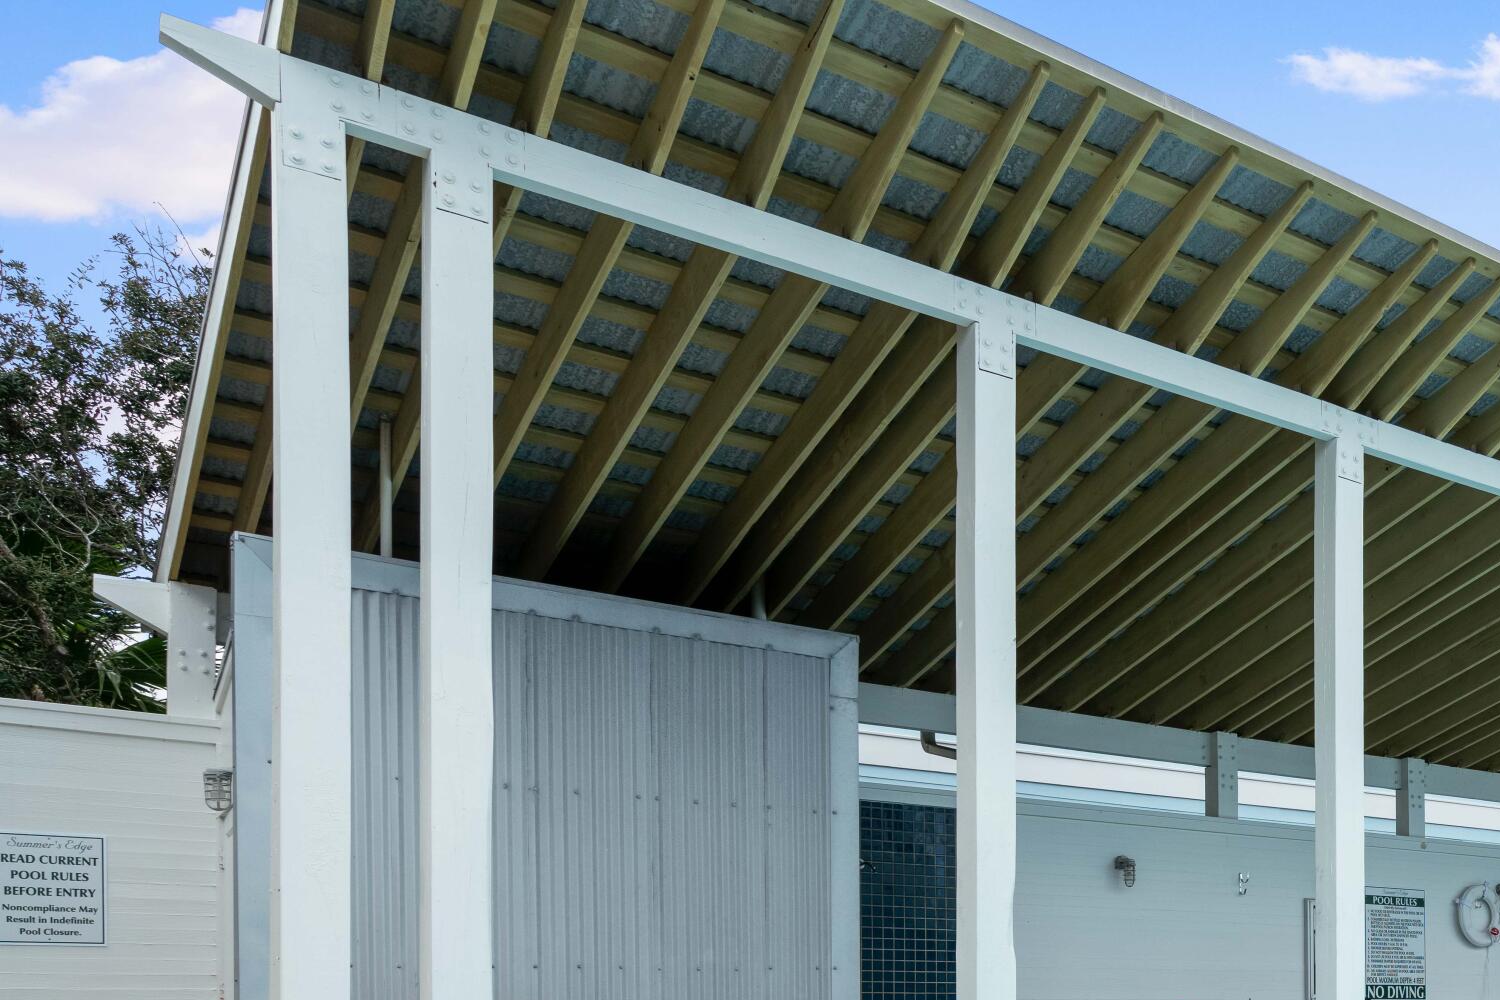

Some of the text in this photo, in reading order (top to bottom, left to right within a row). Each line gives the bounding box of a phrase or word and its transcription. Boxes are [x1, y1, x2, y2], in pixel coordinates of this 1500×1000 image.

[6, 836, 93, 854] Summer's Edge
[0, 853, 99, 866] READ CURRENT
[10, 870, 89, 881] POOL RULES
[3, 886, 96, 898] BEFORE ENTRY
[1373, 896, 1418, 906] POOL RULES
[2, 903, 98, 915] Noncompliance May
[6, 915, 95, 925] Result in Indefinite
[19, 928, 82, 936] Pool Closure.
[1367, 985, 1425, 999] NO DIVING
